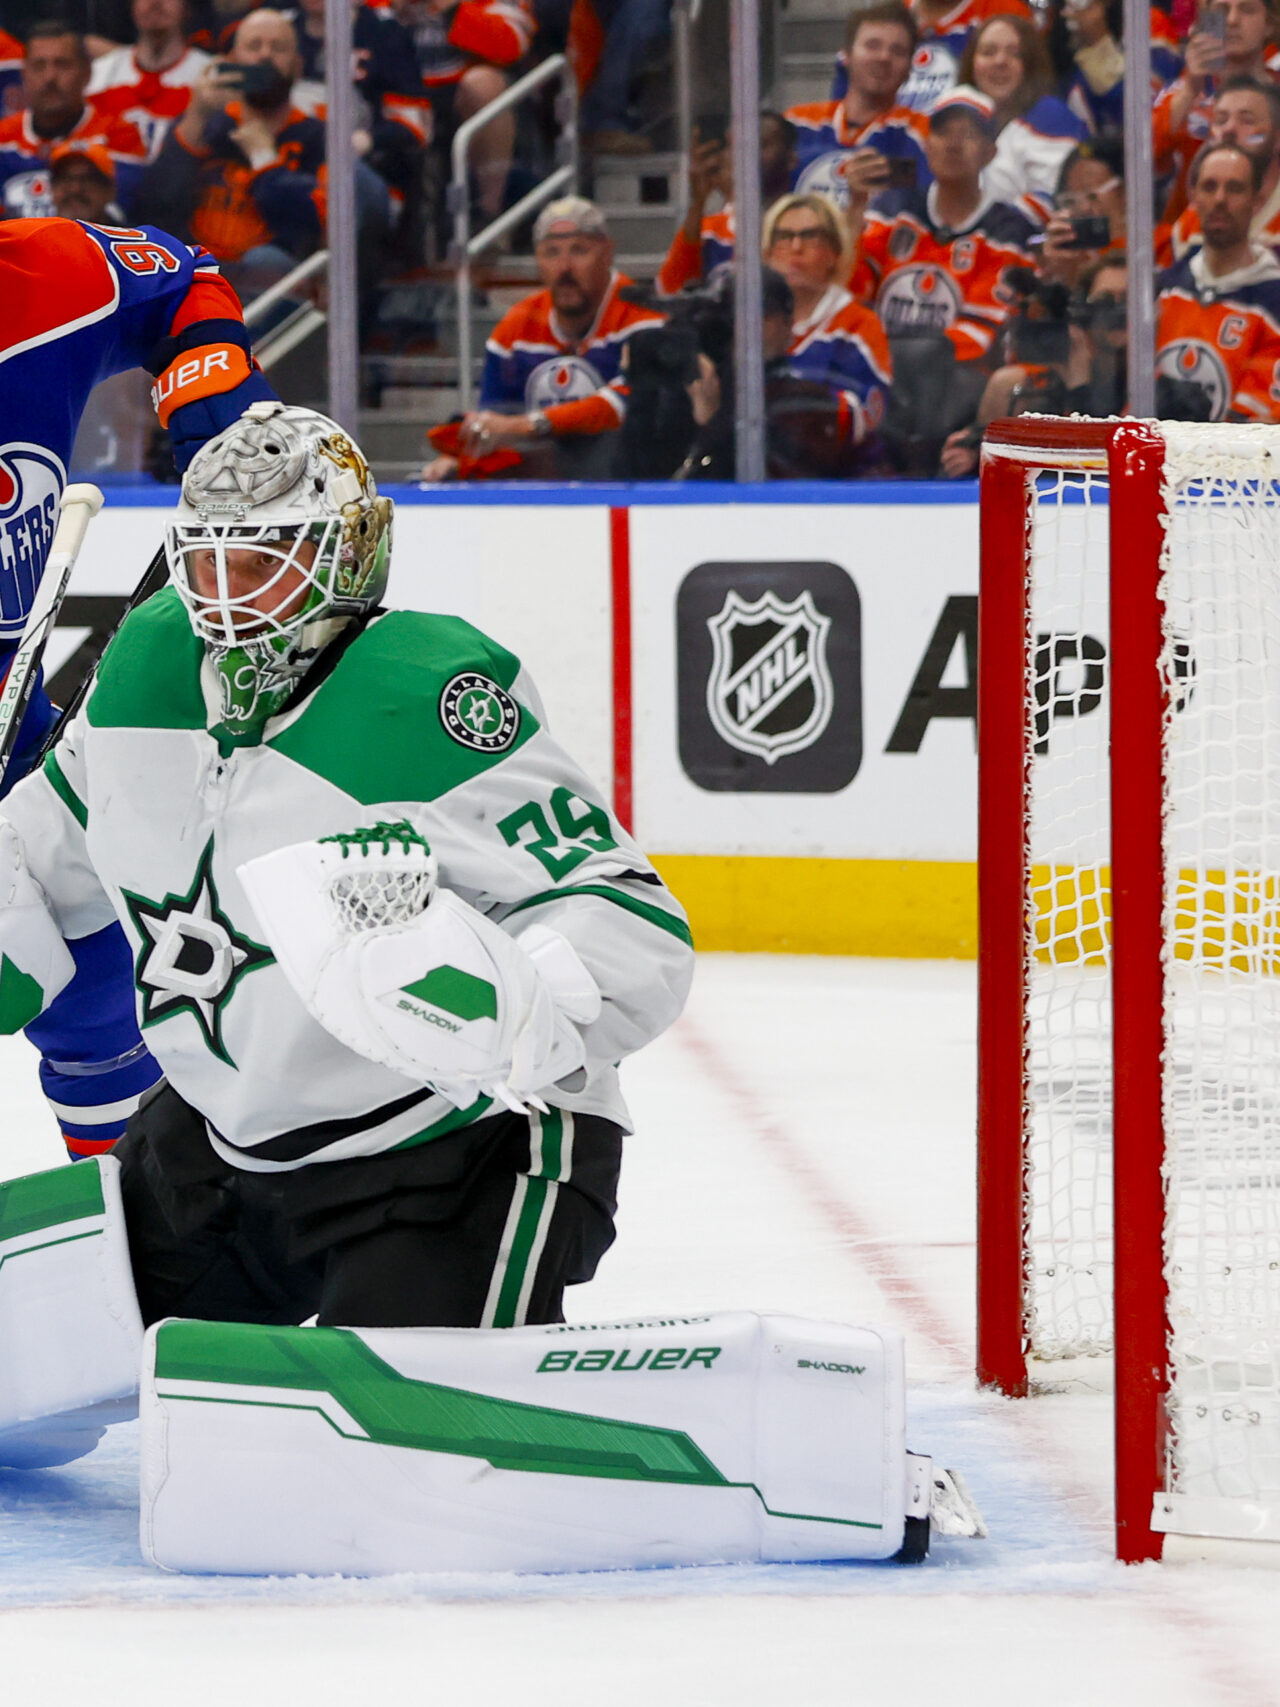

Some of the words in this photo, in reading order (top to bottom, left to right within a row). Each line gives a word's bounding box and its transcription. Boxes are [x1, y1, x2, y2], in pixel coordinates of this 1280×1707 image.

[1217, 313, 1248, 350] C
[150, 349, 231, 415] UER
[735, 635, 808, 723] NHL
[445, 678, 497, 727] DALLAS
[472, 707, 515, 747] STARS
[495, 786, 620, 884] 29
[396, 999, 464, 1034] SHADOW
[796, 1359, 867, 1376] SHADOW
